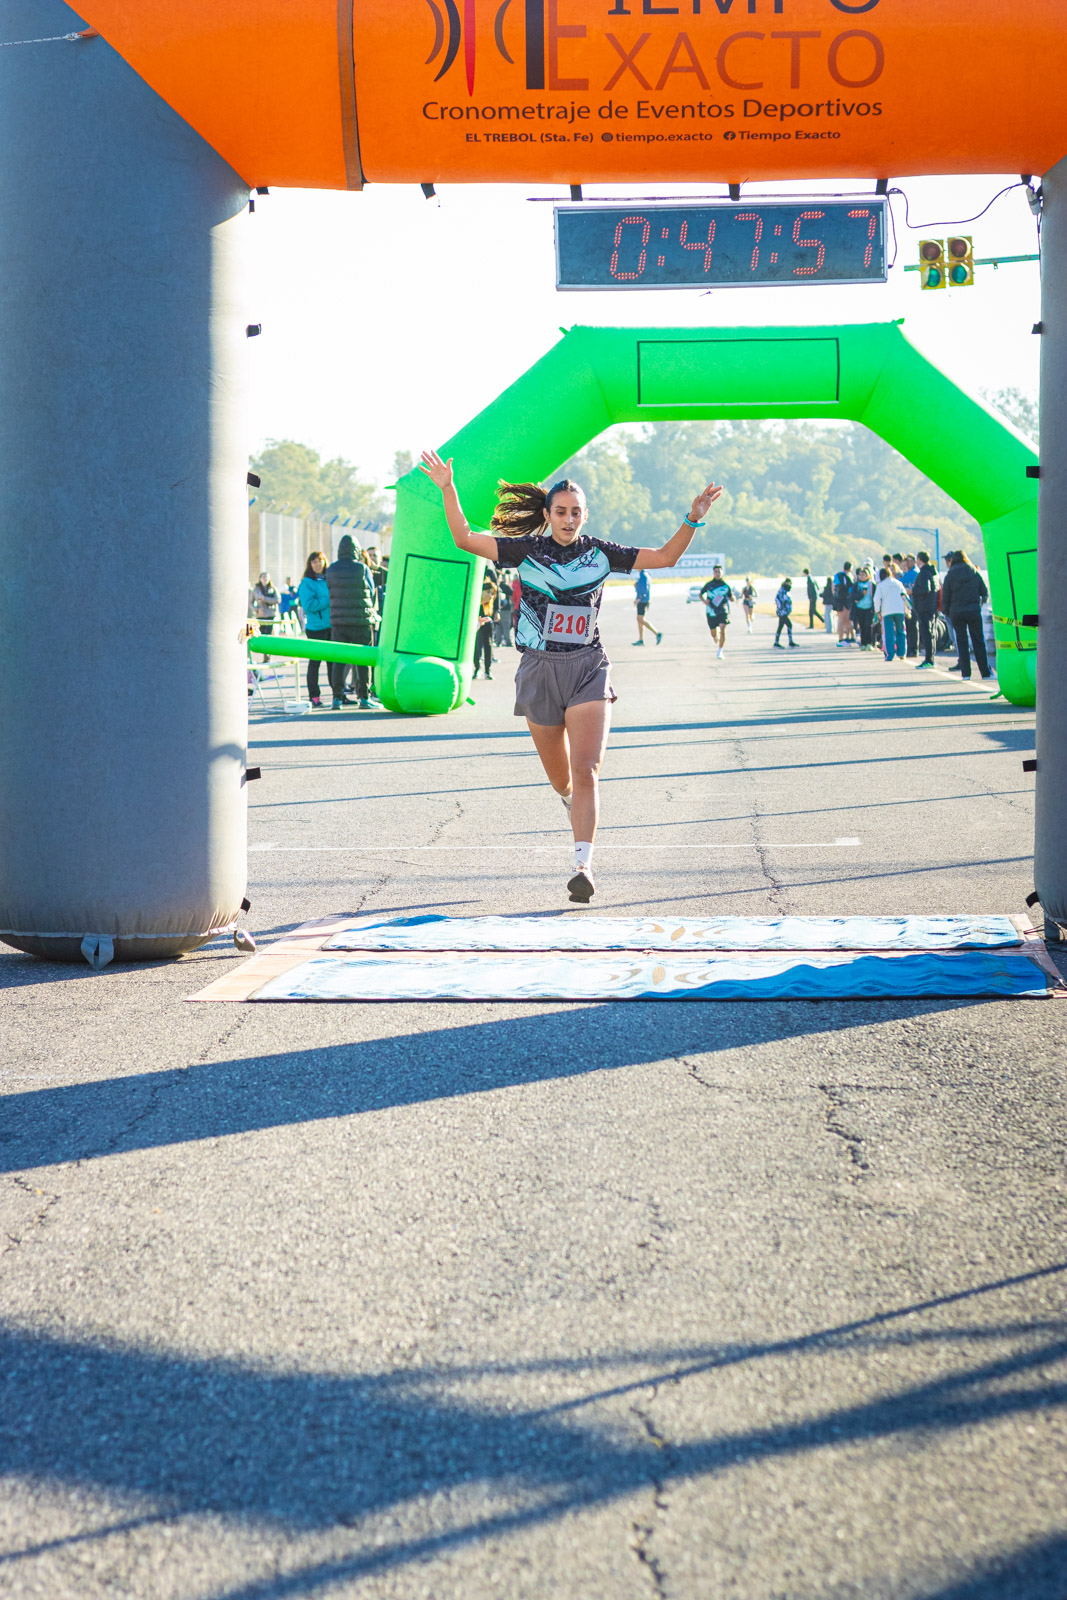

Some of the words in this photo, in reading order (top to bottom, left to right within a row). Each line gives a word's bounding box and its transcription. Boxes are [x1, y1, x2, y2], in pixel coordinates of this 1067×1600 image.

[422, 101, 591, 124] Cronometraje
[597, 100, 629, 119] de
[637, 100, 735, 119] Eventos
[743, 98, 883, 122] Deportivos
[465, 133, 481, 143] EL
[484, 133, 537, 143] TREBOL
[540, 132, 571, 144] (Sta.
[573, 132, 594, 144] Fe)
[616, 131, 713, 144] tiempo.exacto
[738, 130, 792, 142] Tiempo
[795, 130, 842, 141] Exacto
[553, 613, 586, 636] 210
